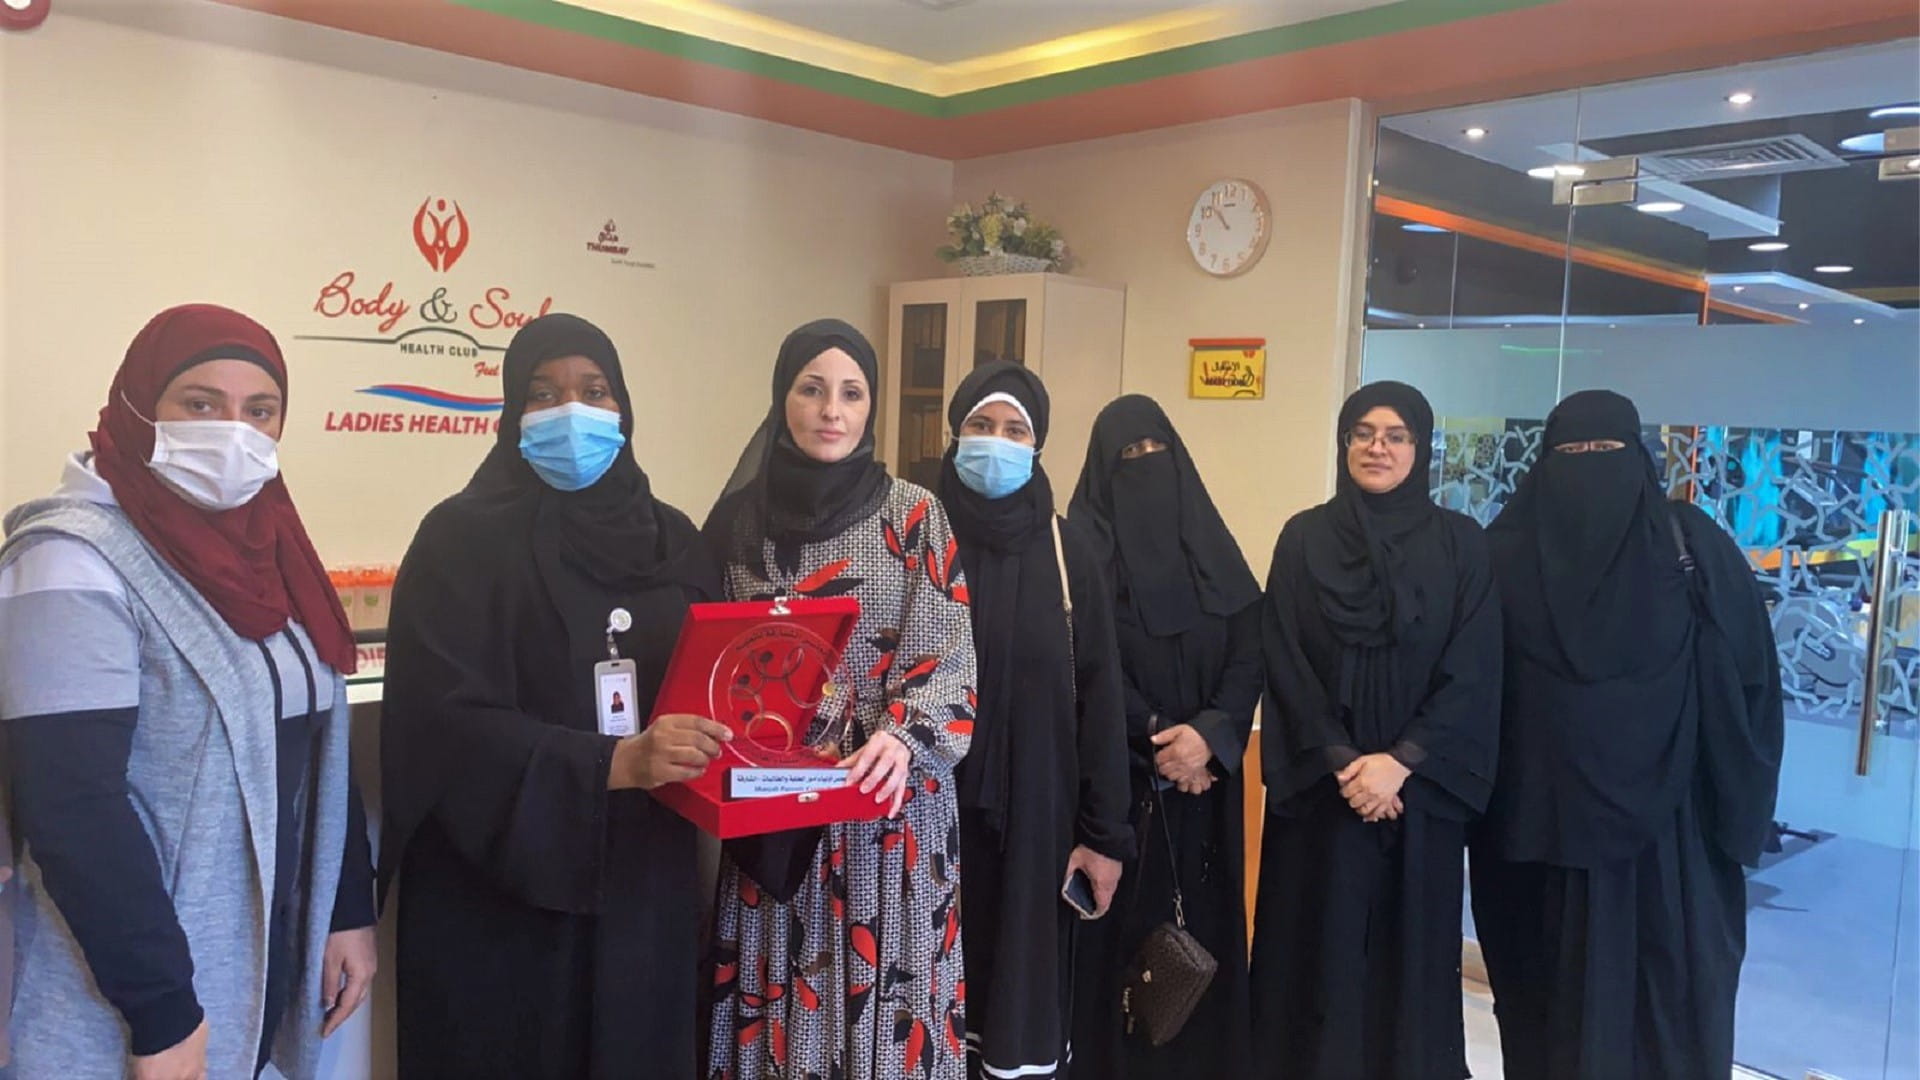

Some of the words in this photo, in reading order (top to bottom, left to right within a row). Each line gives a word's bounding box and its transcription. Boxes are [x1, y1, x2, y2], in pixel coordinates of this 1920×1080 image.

[313, 271, 410, 334] Body
[419, 287, 458, 324] &
[400, 343, 445, 355] HEALTH
[448, 346, 479, 358] CLUB
[324, 411, 404, 432] LADIES
[408, 414, 489, 435] HEALTH
